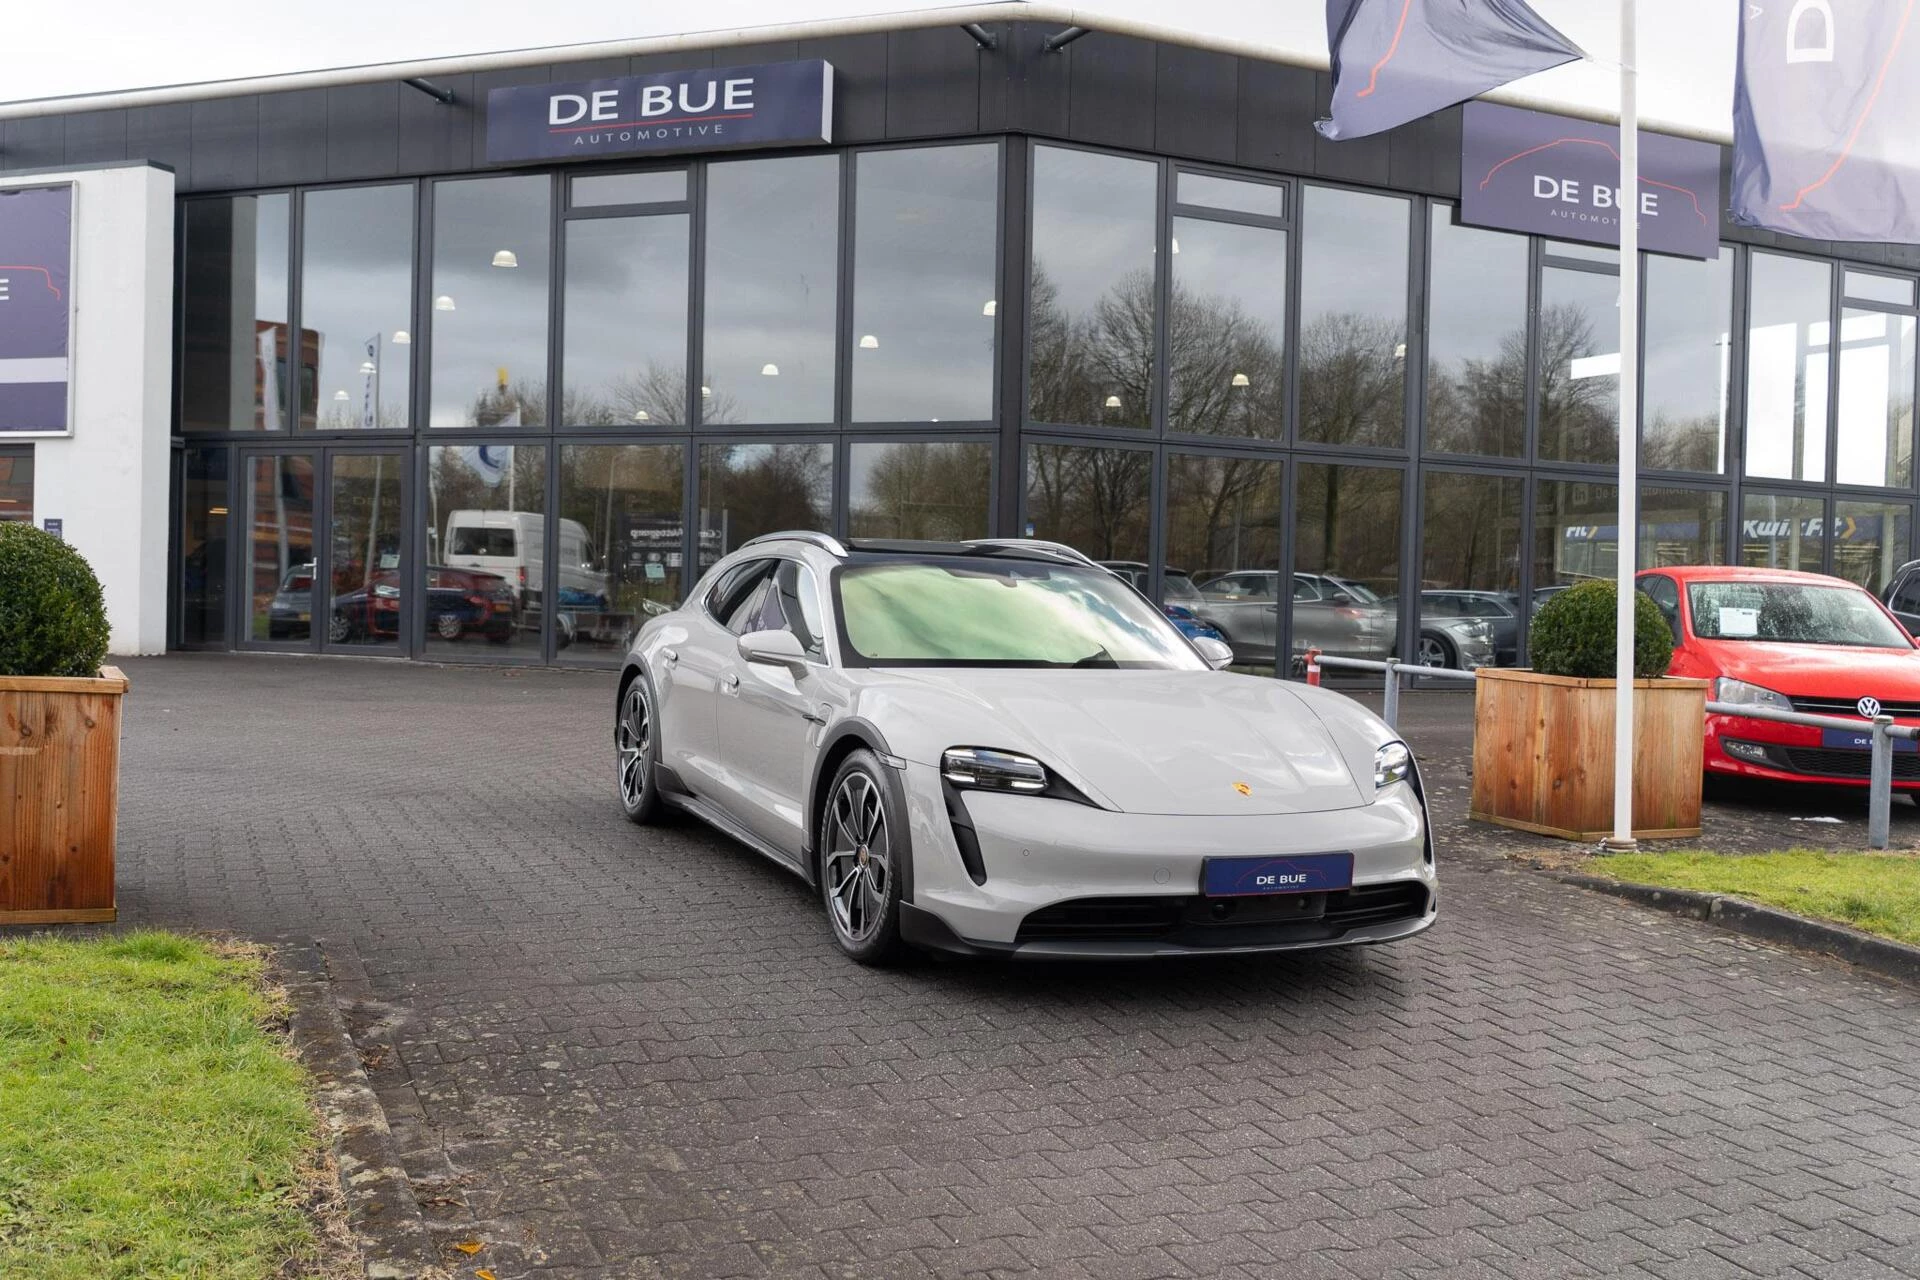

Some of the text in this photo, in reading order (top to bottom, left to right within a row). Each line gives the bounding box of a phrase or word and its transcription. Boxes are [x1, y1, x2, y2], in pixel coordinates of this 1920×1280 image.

[549, 78, 754, 125] DE BUE
[574, 124, 723, 145] AUTOMOTIVE
[1533, 175, 1659, 217] DE BE
[1744, 518, 1804, 538] Kwi
[1256, 873, 1307, 885] DE BUE
